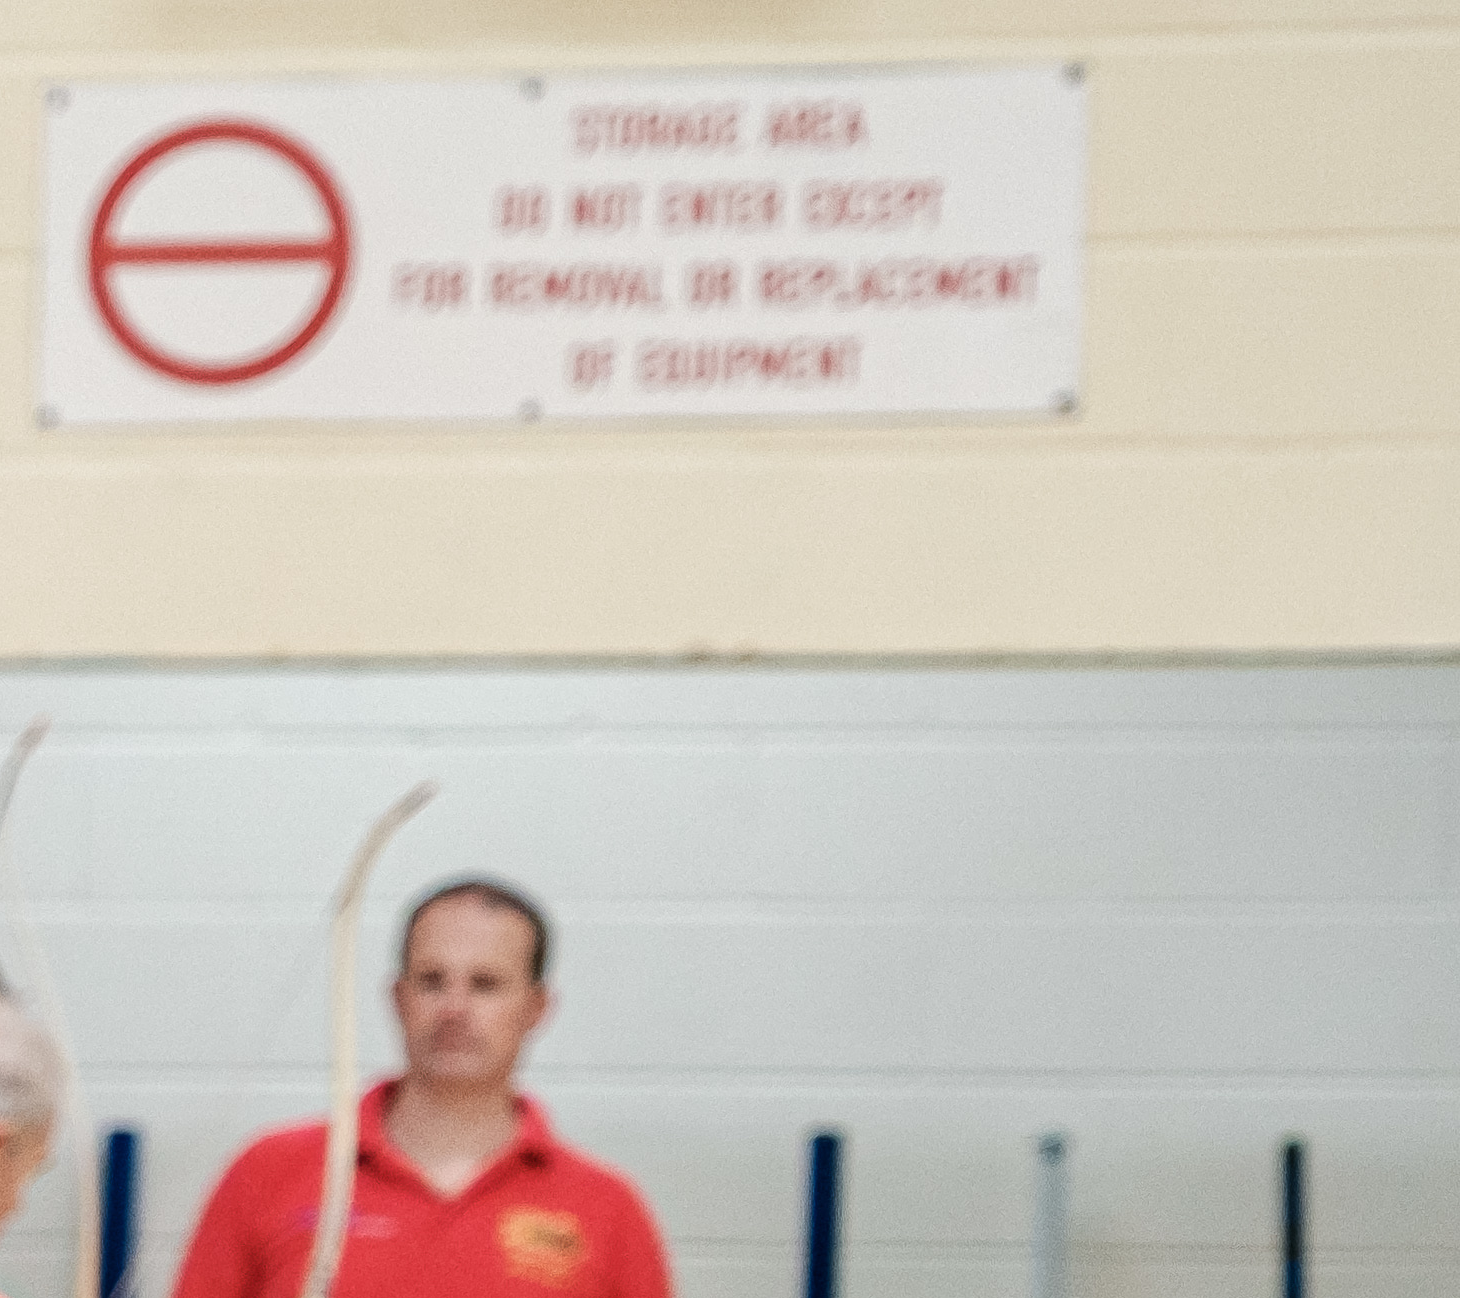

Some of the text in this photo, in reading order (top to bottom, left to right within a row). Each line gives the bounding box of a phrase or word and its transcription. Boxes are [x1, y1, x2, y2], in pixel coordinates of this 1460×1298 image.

[576, 103, 865, 148] STORAGE AREA
[498, 179, 941, 231] DO NOT ENTER EXCEPT
[396, 257, 1035, 306] FOR REMOVAL OR REPLACEMENT
[570, 337, 859, 386] OF EQUIPMENT
